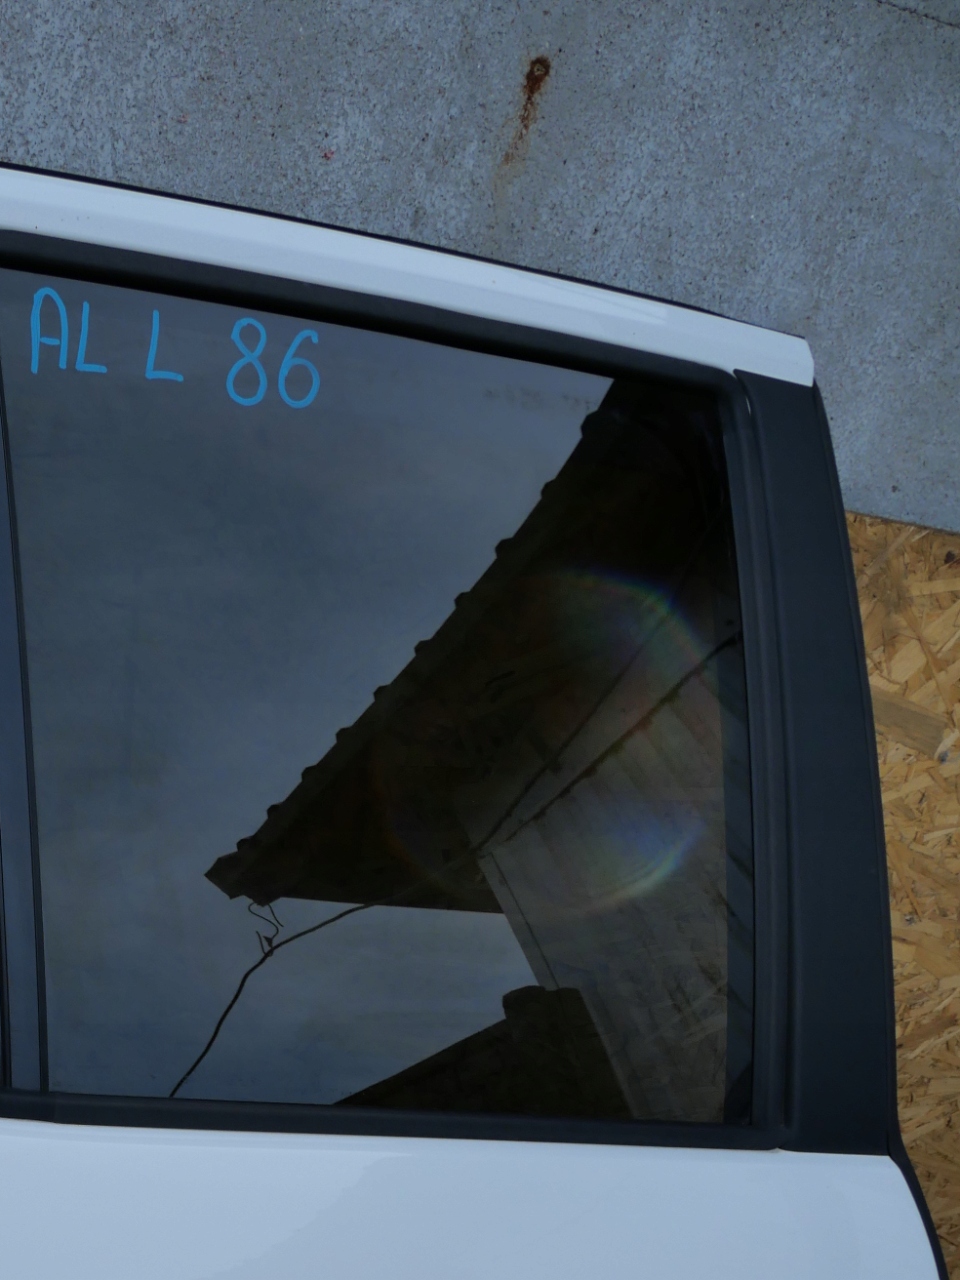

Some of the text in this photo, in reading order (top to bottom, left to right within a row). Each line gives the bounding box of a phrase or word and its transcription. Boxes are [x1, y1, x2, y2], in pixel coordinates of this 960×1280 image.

[31, 287, 320, 408] AL L 86
